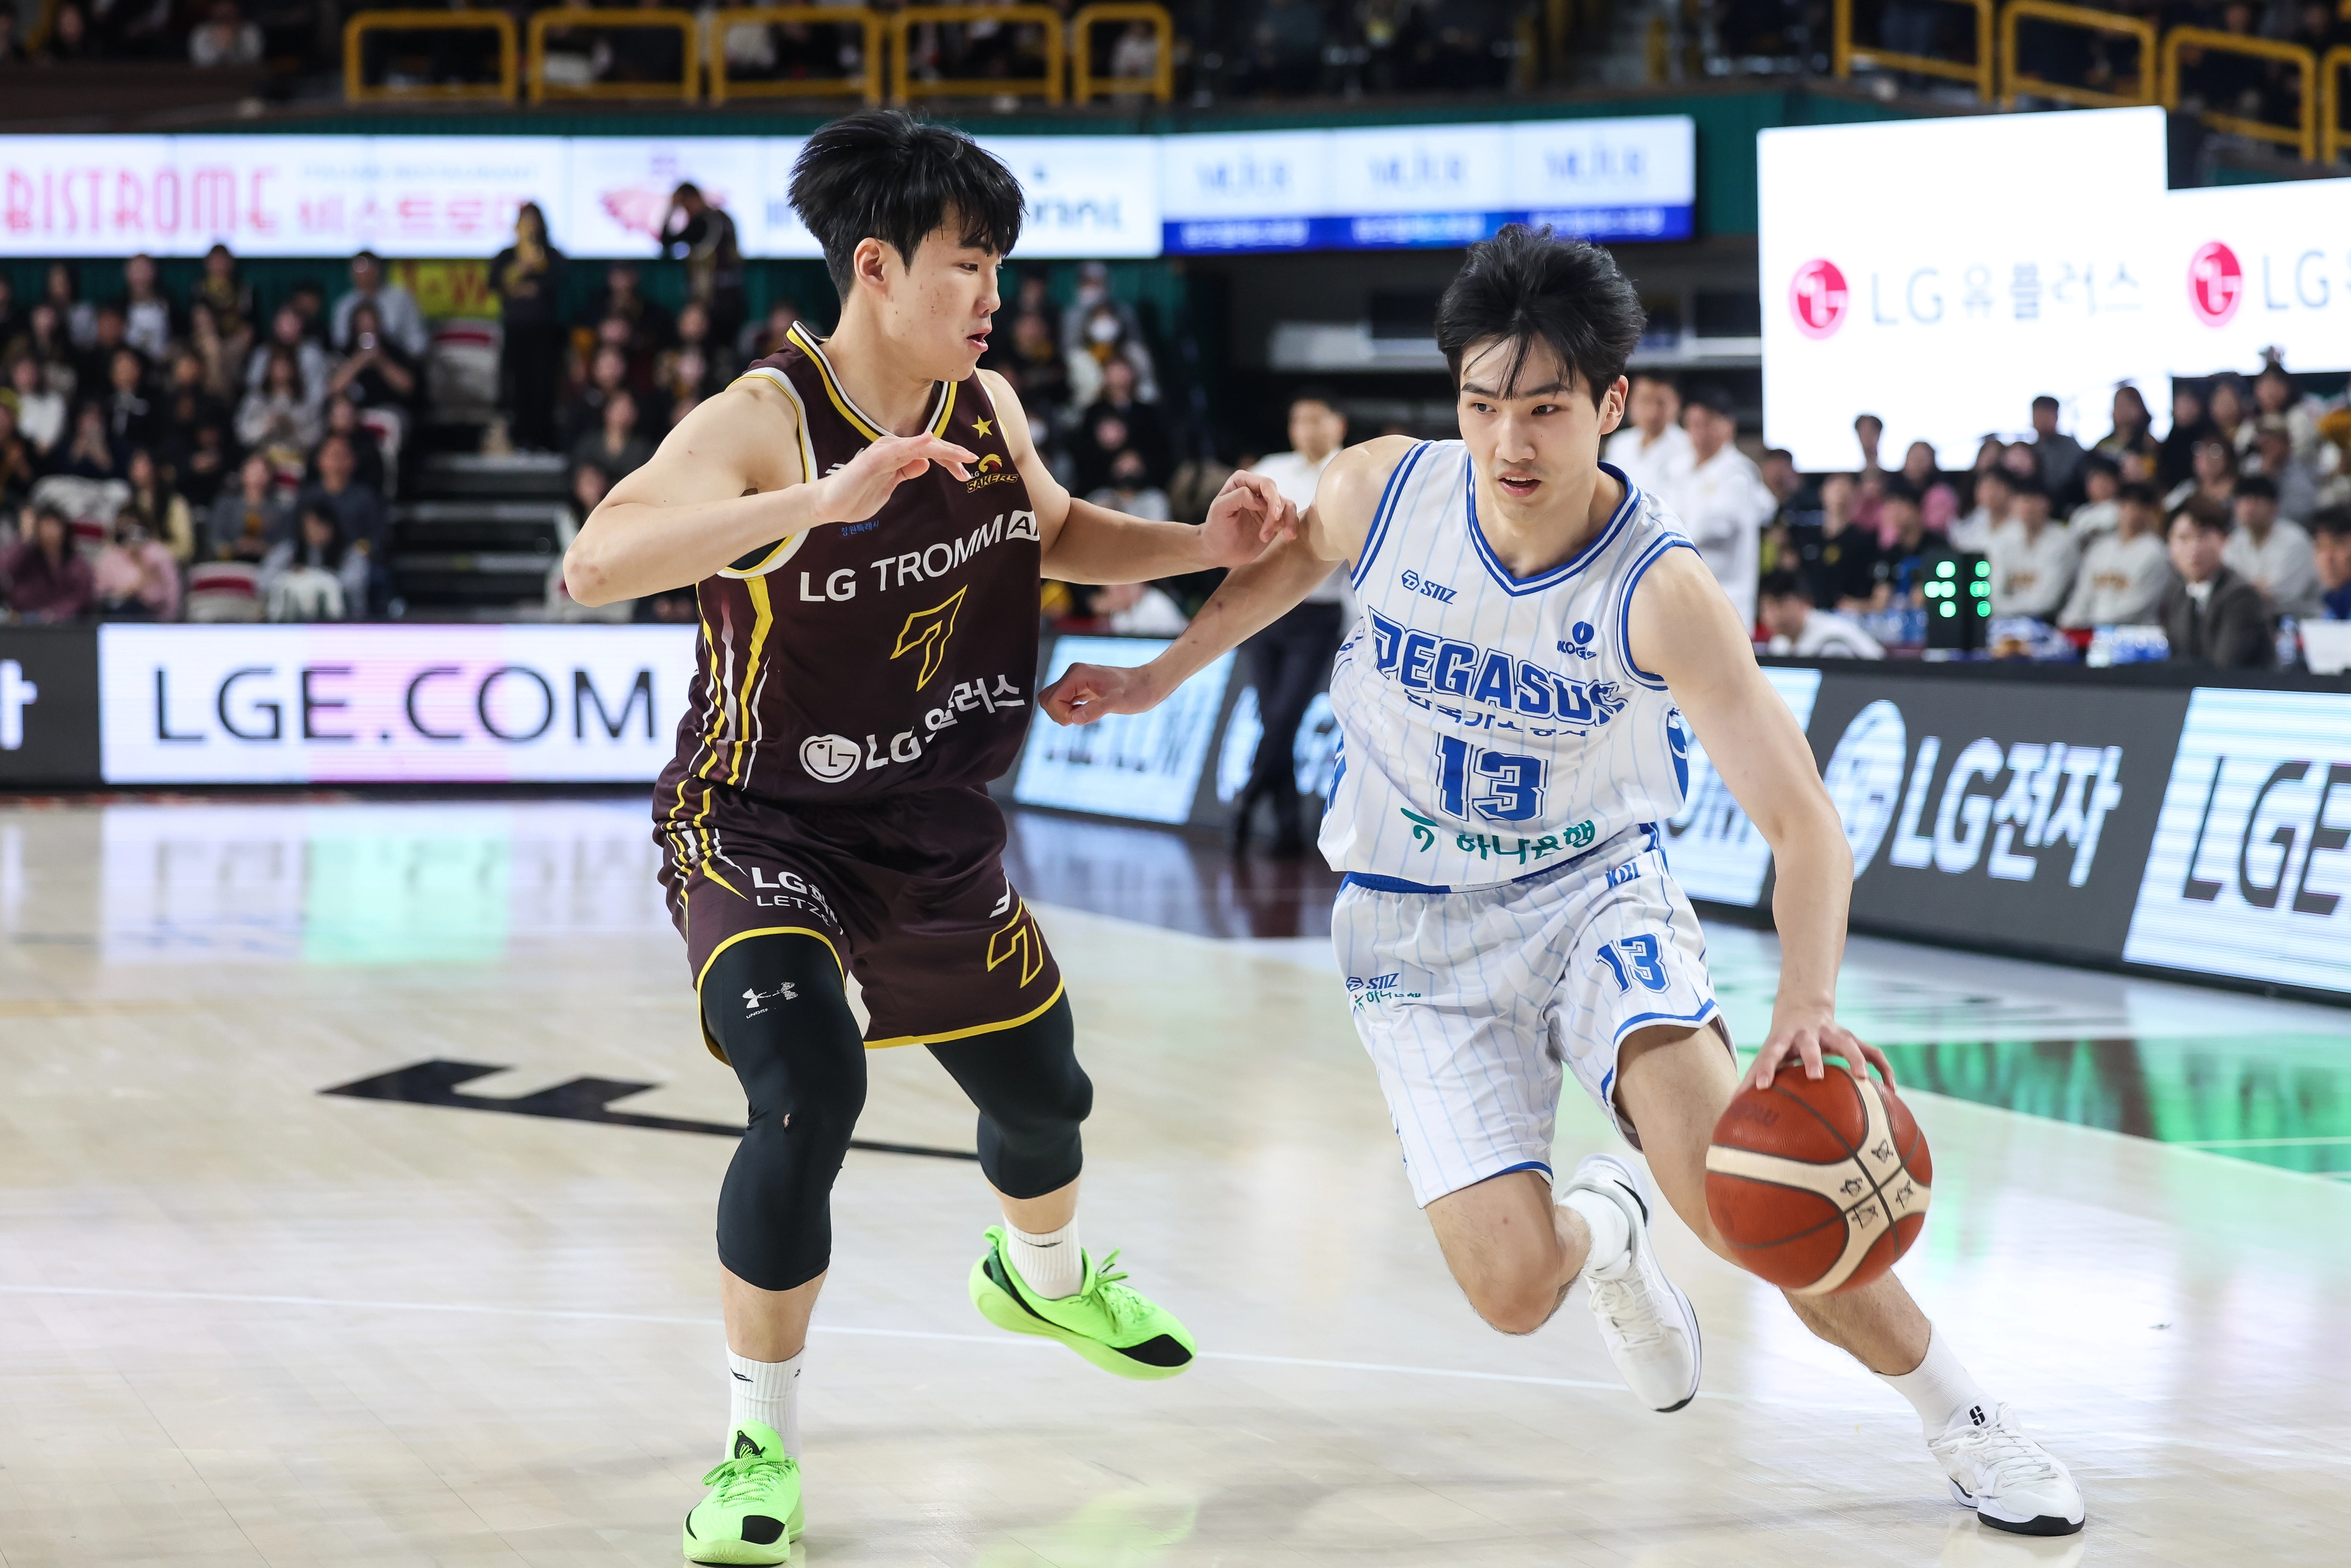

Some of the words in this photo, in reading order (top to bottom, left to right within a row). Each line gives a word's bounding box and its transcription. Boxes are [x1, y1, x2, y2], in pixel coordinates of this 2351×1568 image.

[2262, 249, 2351, 311] LG
[967, 473, 1019, 493] SAKERS
[800, 568, 856, 602] LG
[870, 513, 1004, 592] TROMM
[840, 520, 879, 536] 창원특례시
[889, 584, 968, 692] 7
[156, 665, 656, 742] LGE.COM
[1435, 731, 1548, 822] 13
[1456, 819, 1596, 865] 하나은행
[1595, 933, 1672, 997] 13
